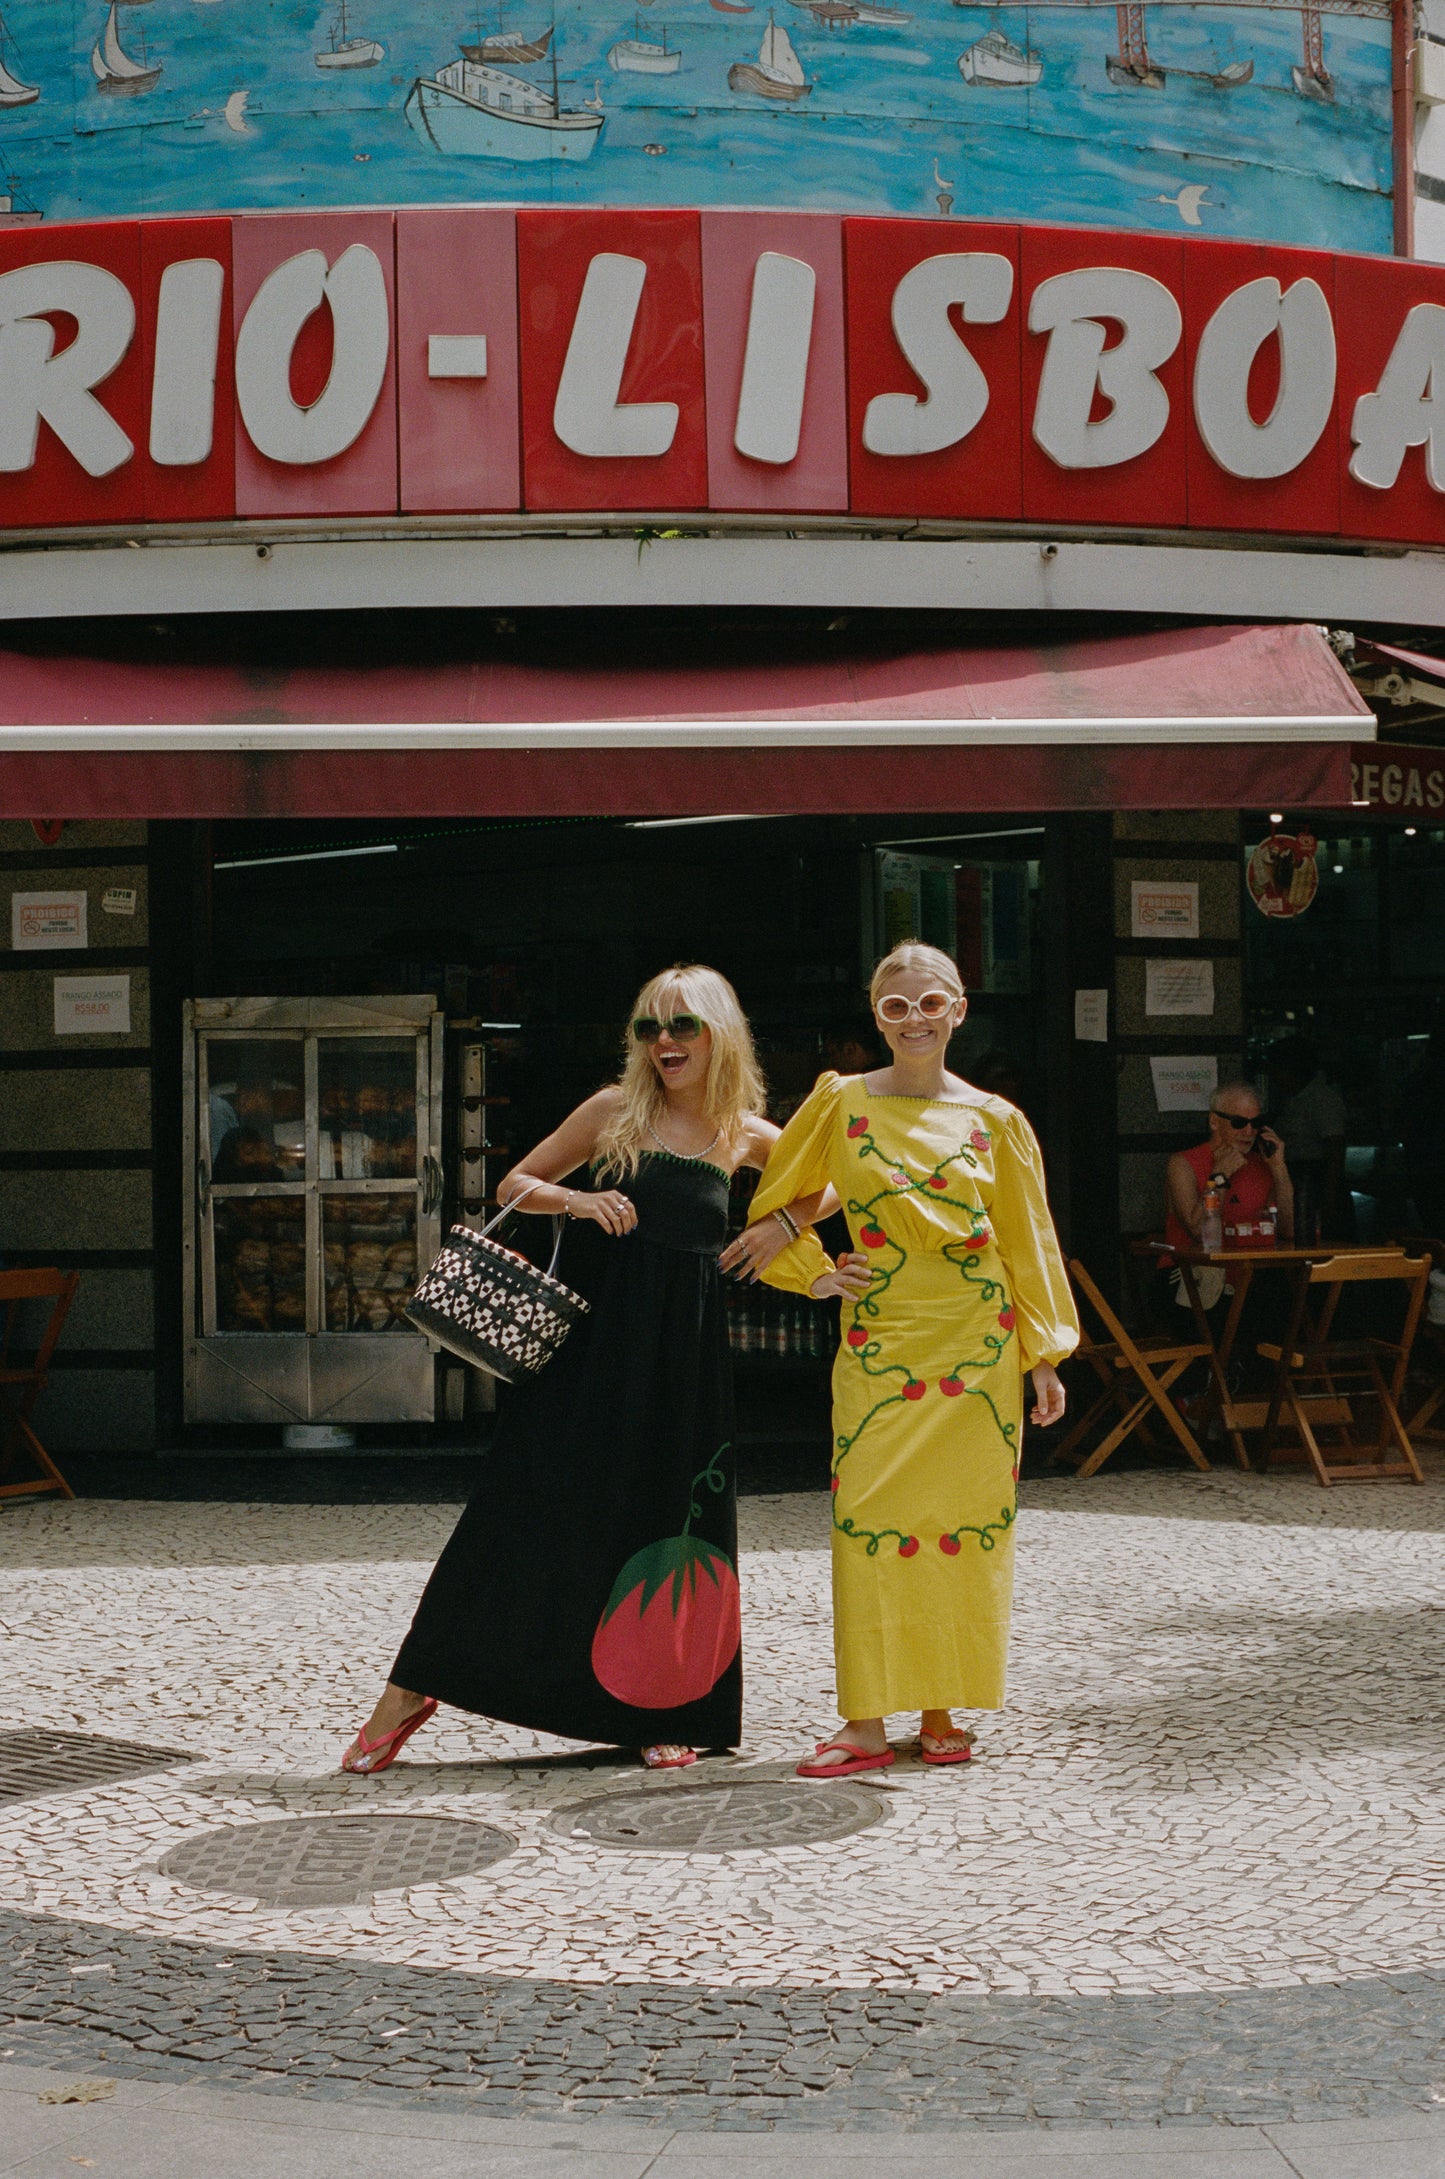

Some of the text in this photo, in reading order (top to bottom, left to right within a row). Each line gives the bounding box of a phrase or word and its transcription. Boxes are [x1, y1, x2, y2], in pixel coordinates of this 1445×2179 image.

[0, 243, 390, 478] RIO
[23, 907, 76, 920] PROIBIDO
[61, 991, 92, 1000] FRANGO
[479, 1261, 521, 1289] MARNI
